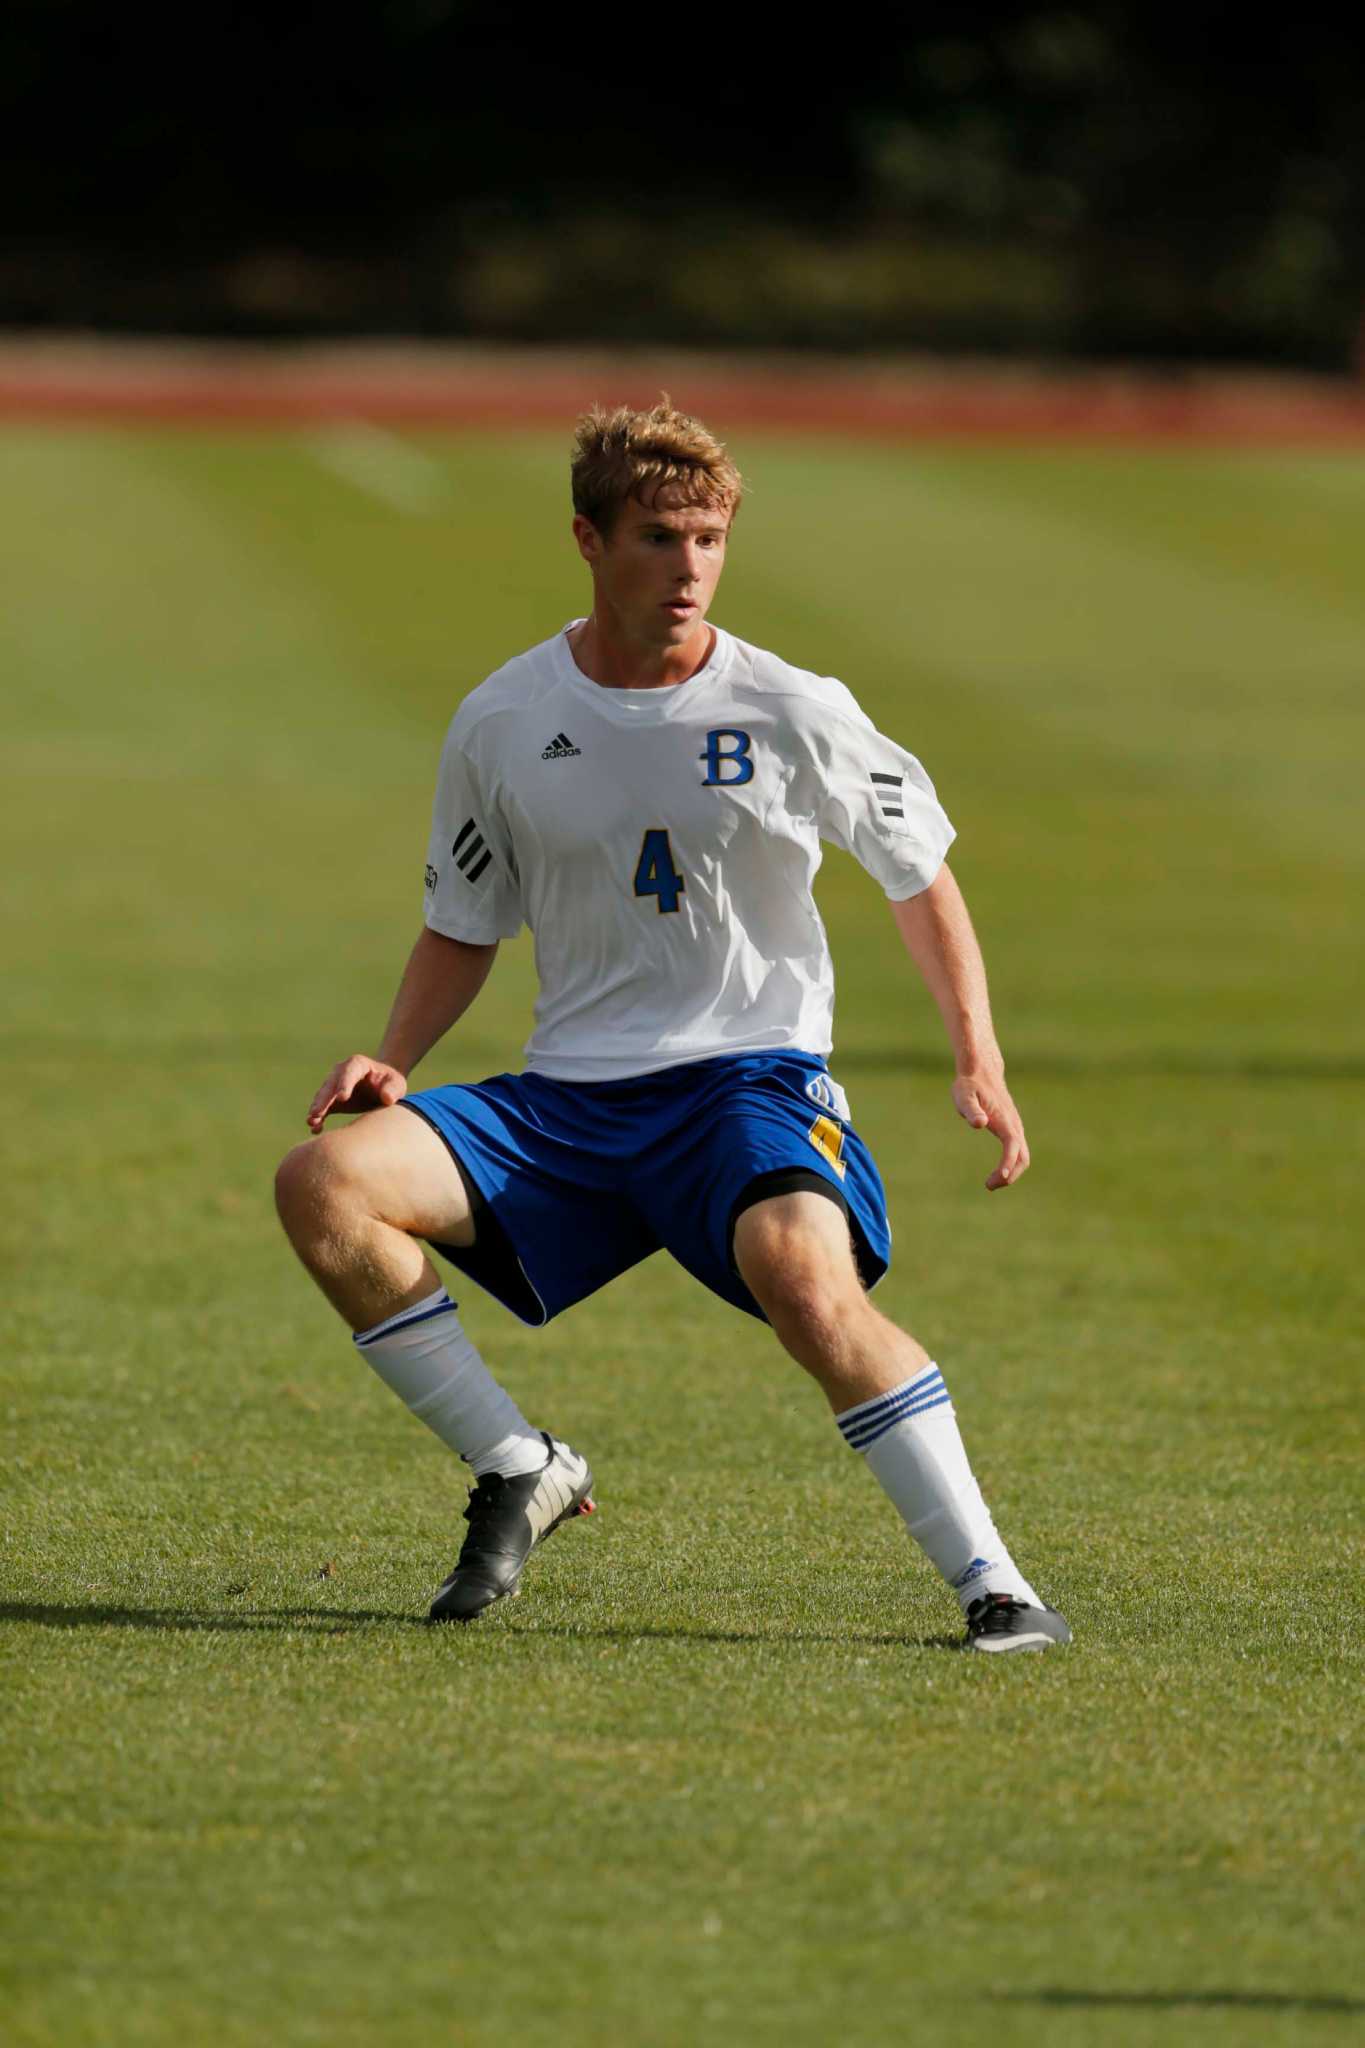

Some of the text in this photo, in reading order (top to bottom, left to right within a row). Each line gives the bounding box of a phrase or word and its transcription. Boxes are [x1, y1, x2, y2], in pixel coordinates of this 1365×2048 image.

[540, 747, 582, 760] adidas
[699, 728, 755, 786] B
[633, 828, 685, 914] 4
